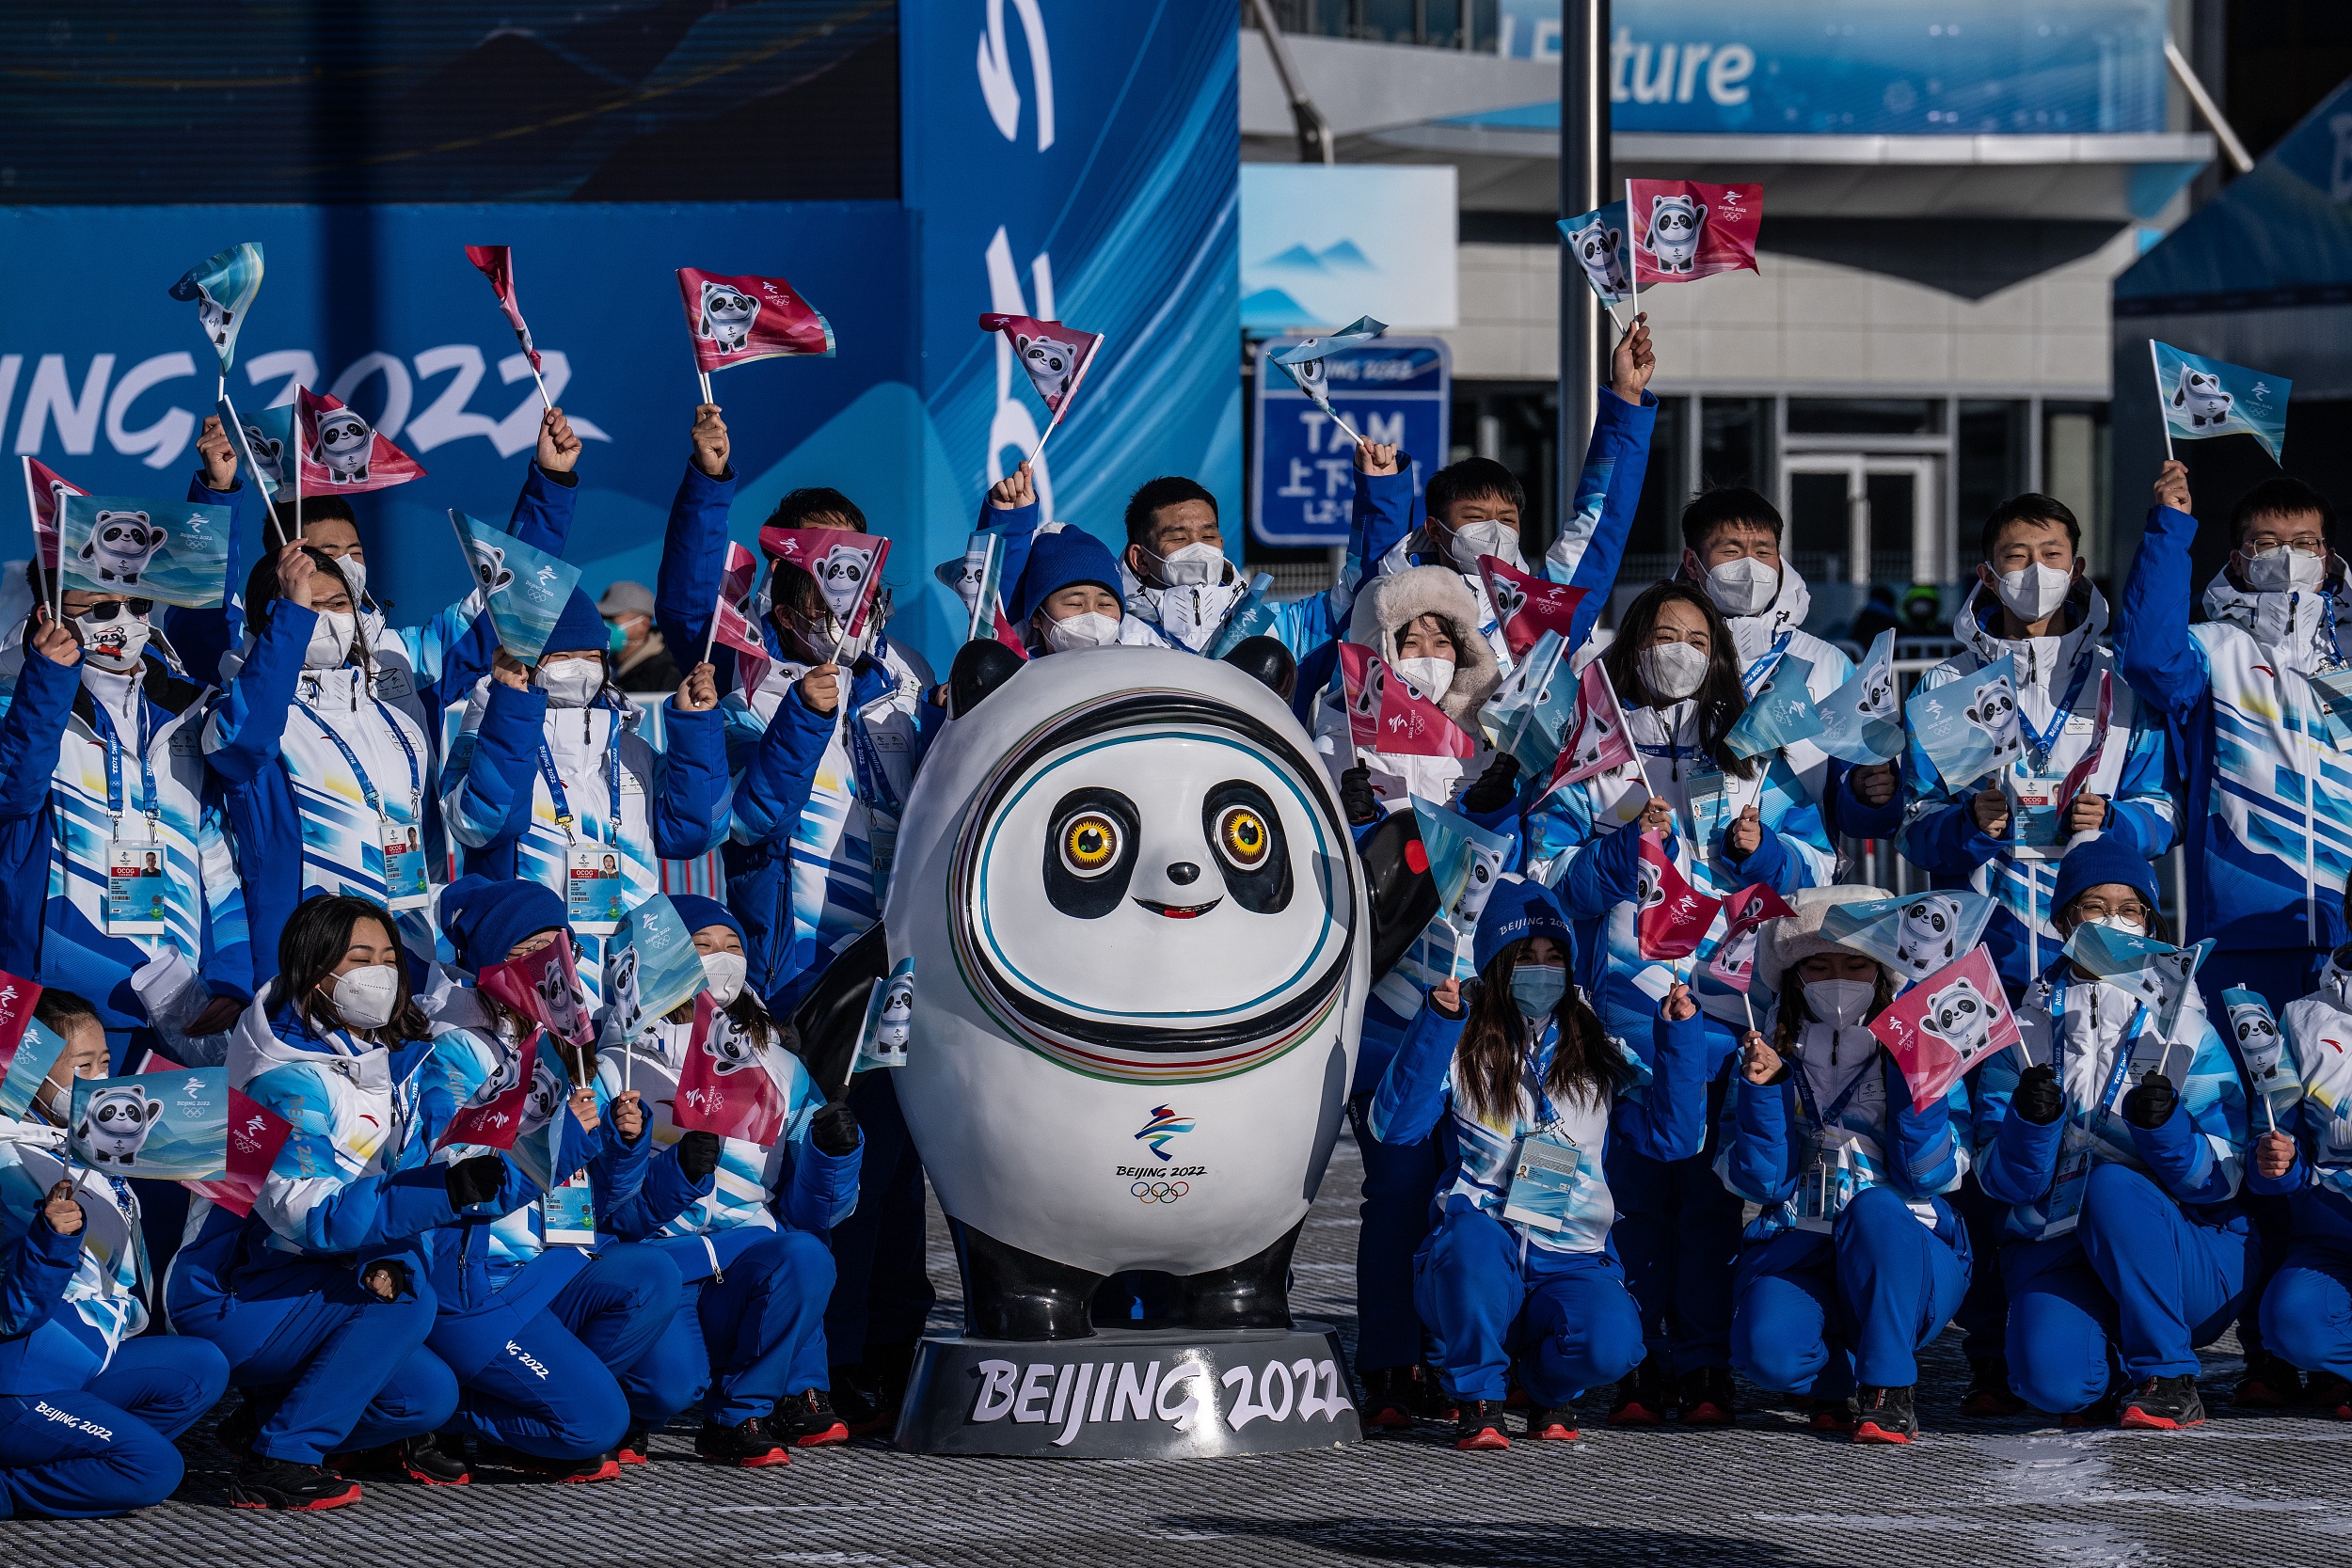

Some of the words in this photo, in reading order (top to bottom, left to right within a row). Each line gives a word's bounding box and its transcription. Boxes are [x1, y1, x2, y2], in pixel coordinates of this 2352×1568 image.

[1299, 411, 1406, 454] TAM
[525, 580, 542, 592] BEIJING
[542, 588, 554, 597] 2022
[1752, 663, 1765, 677] 2022
[2048, 716, 2063, 737] BEIJING
[2060, 700, 2071, 717] 2022
[109, 732, 119, 754] BEIJING
[329, 731, 342, 744] 2022
[341, 744, 357, 765] BEIJING
[539, 745, 551, 768] BEIJING
[547, 768, 557, 784] 2022
[1500, 917, 1544, 935] BEIJING
[24, 1052, 38, 1062] 2022
[233, 1129, 250, 1142] BEIJING
[248, 1138, 262, 1149] 2022
[1116, 1166, 1167, 1180] BEIJING
[1170, 1166, 1208, 1177] 2022
[518, 1353, 549, 1381] 2022
[972, 1359, 1201, 1447] BEIJING
[1220, 1357, 1355, 1433] 2022
[34, 1401, 81, 1428] BEIJING
[79, 1420, 113, 1443] 2022
